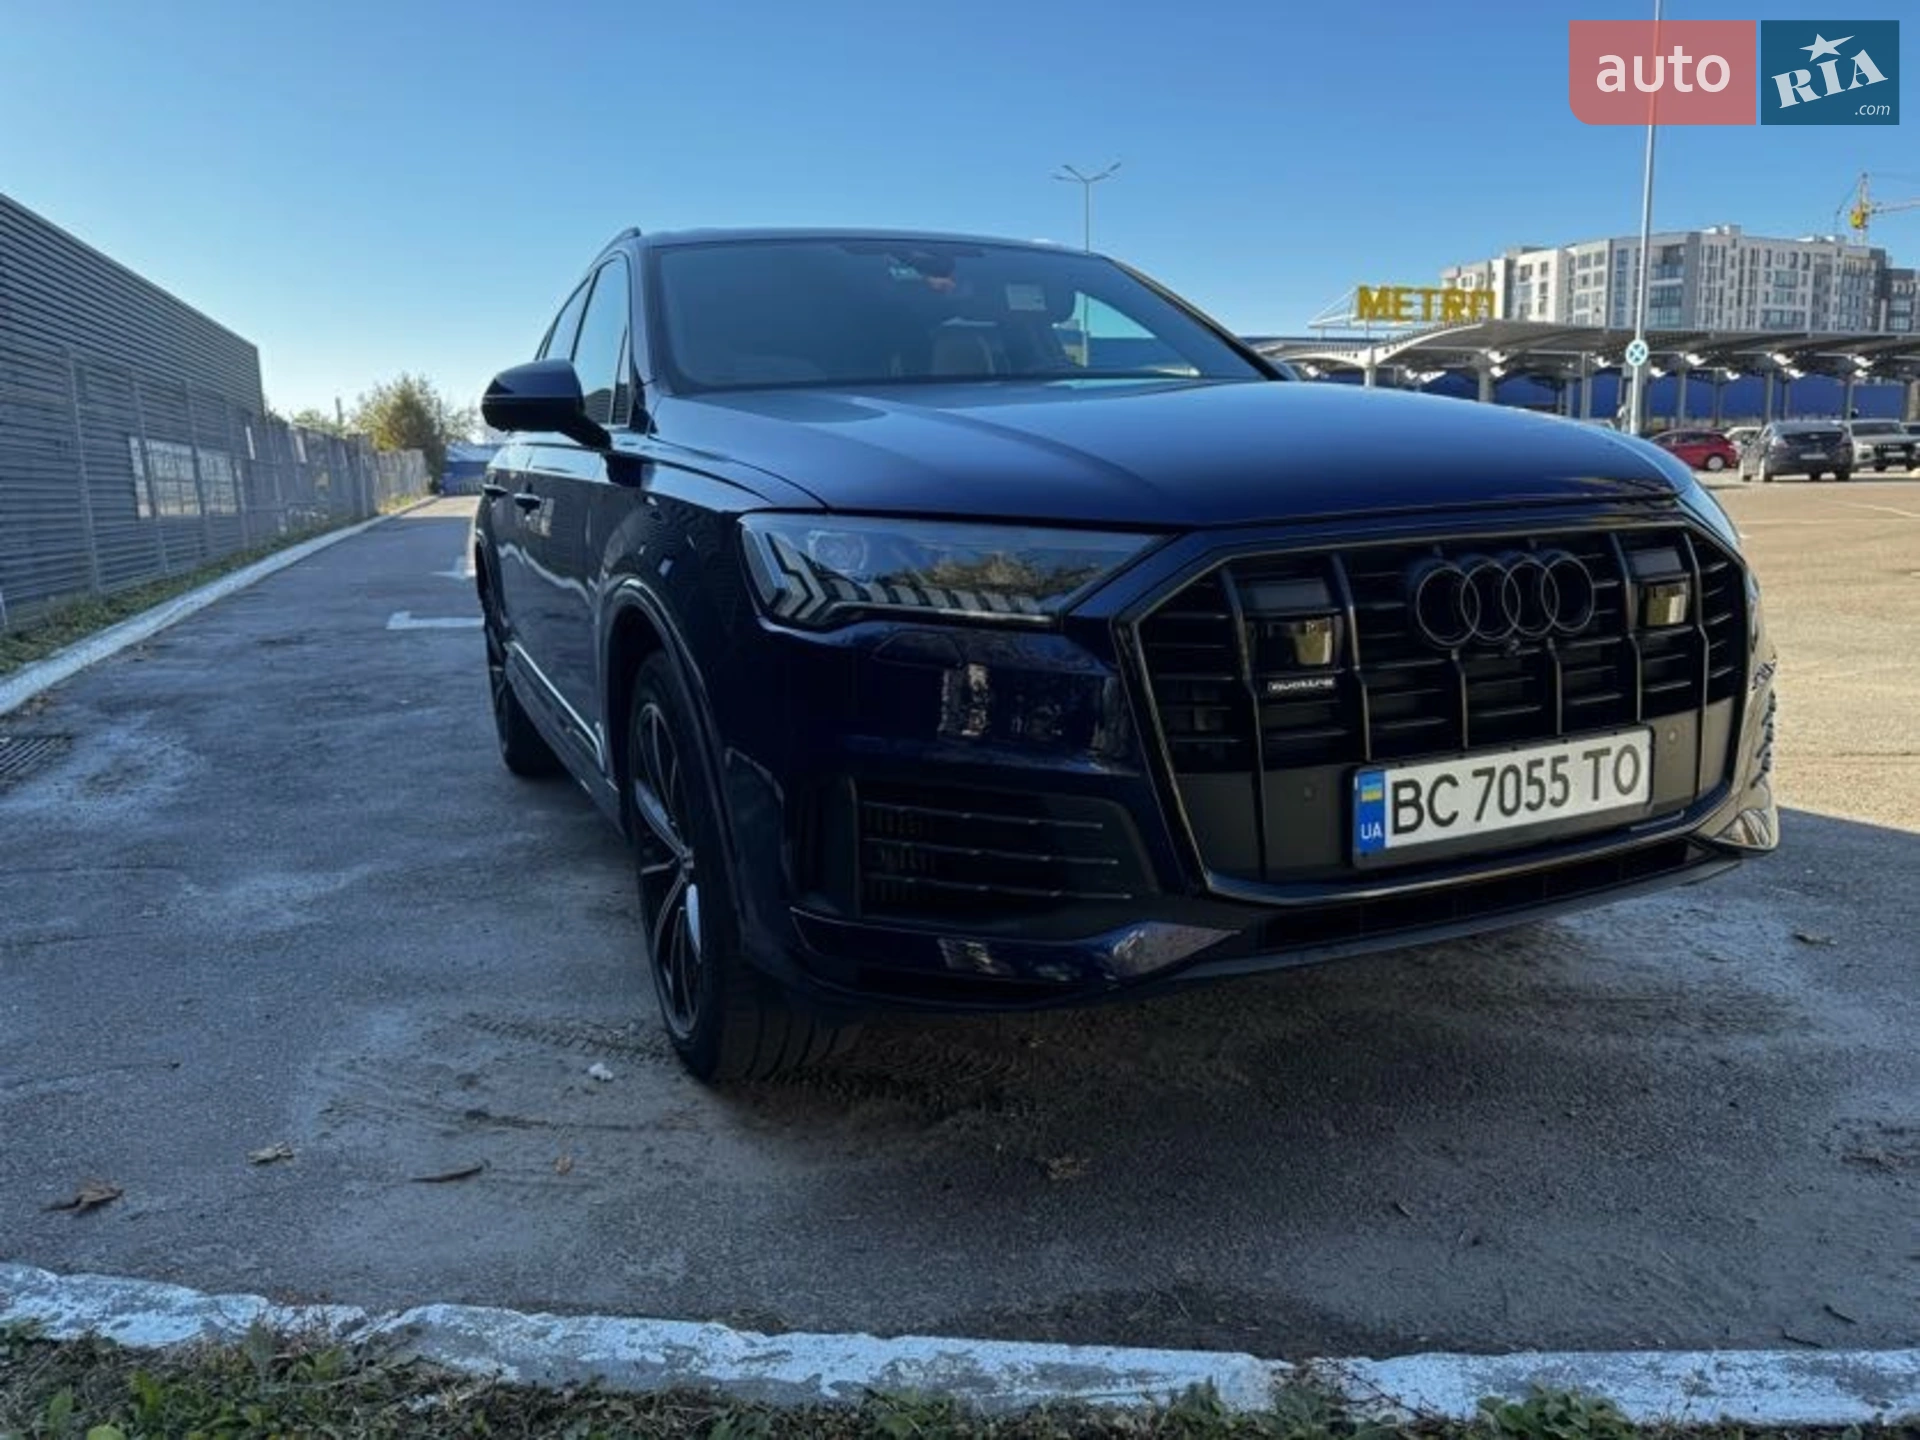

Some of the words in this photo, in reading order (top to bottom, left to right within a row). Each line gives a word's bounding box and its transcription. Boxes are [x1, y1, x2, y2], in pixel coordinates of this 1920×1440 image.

[1358, 284, 1496, 322] METRO
[1391, 773, 1460, 836] BC
[1472, 754, 1571, 822] 7055
[1583, 743, 1642, 801] TO
[1360, 821, 1384, 840] UA
